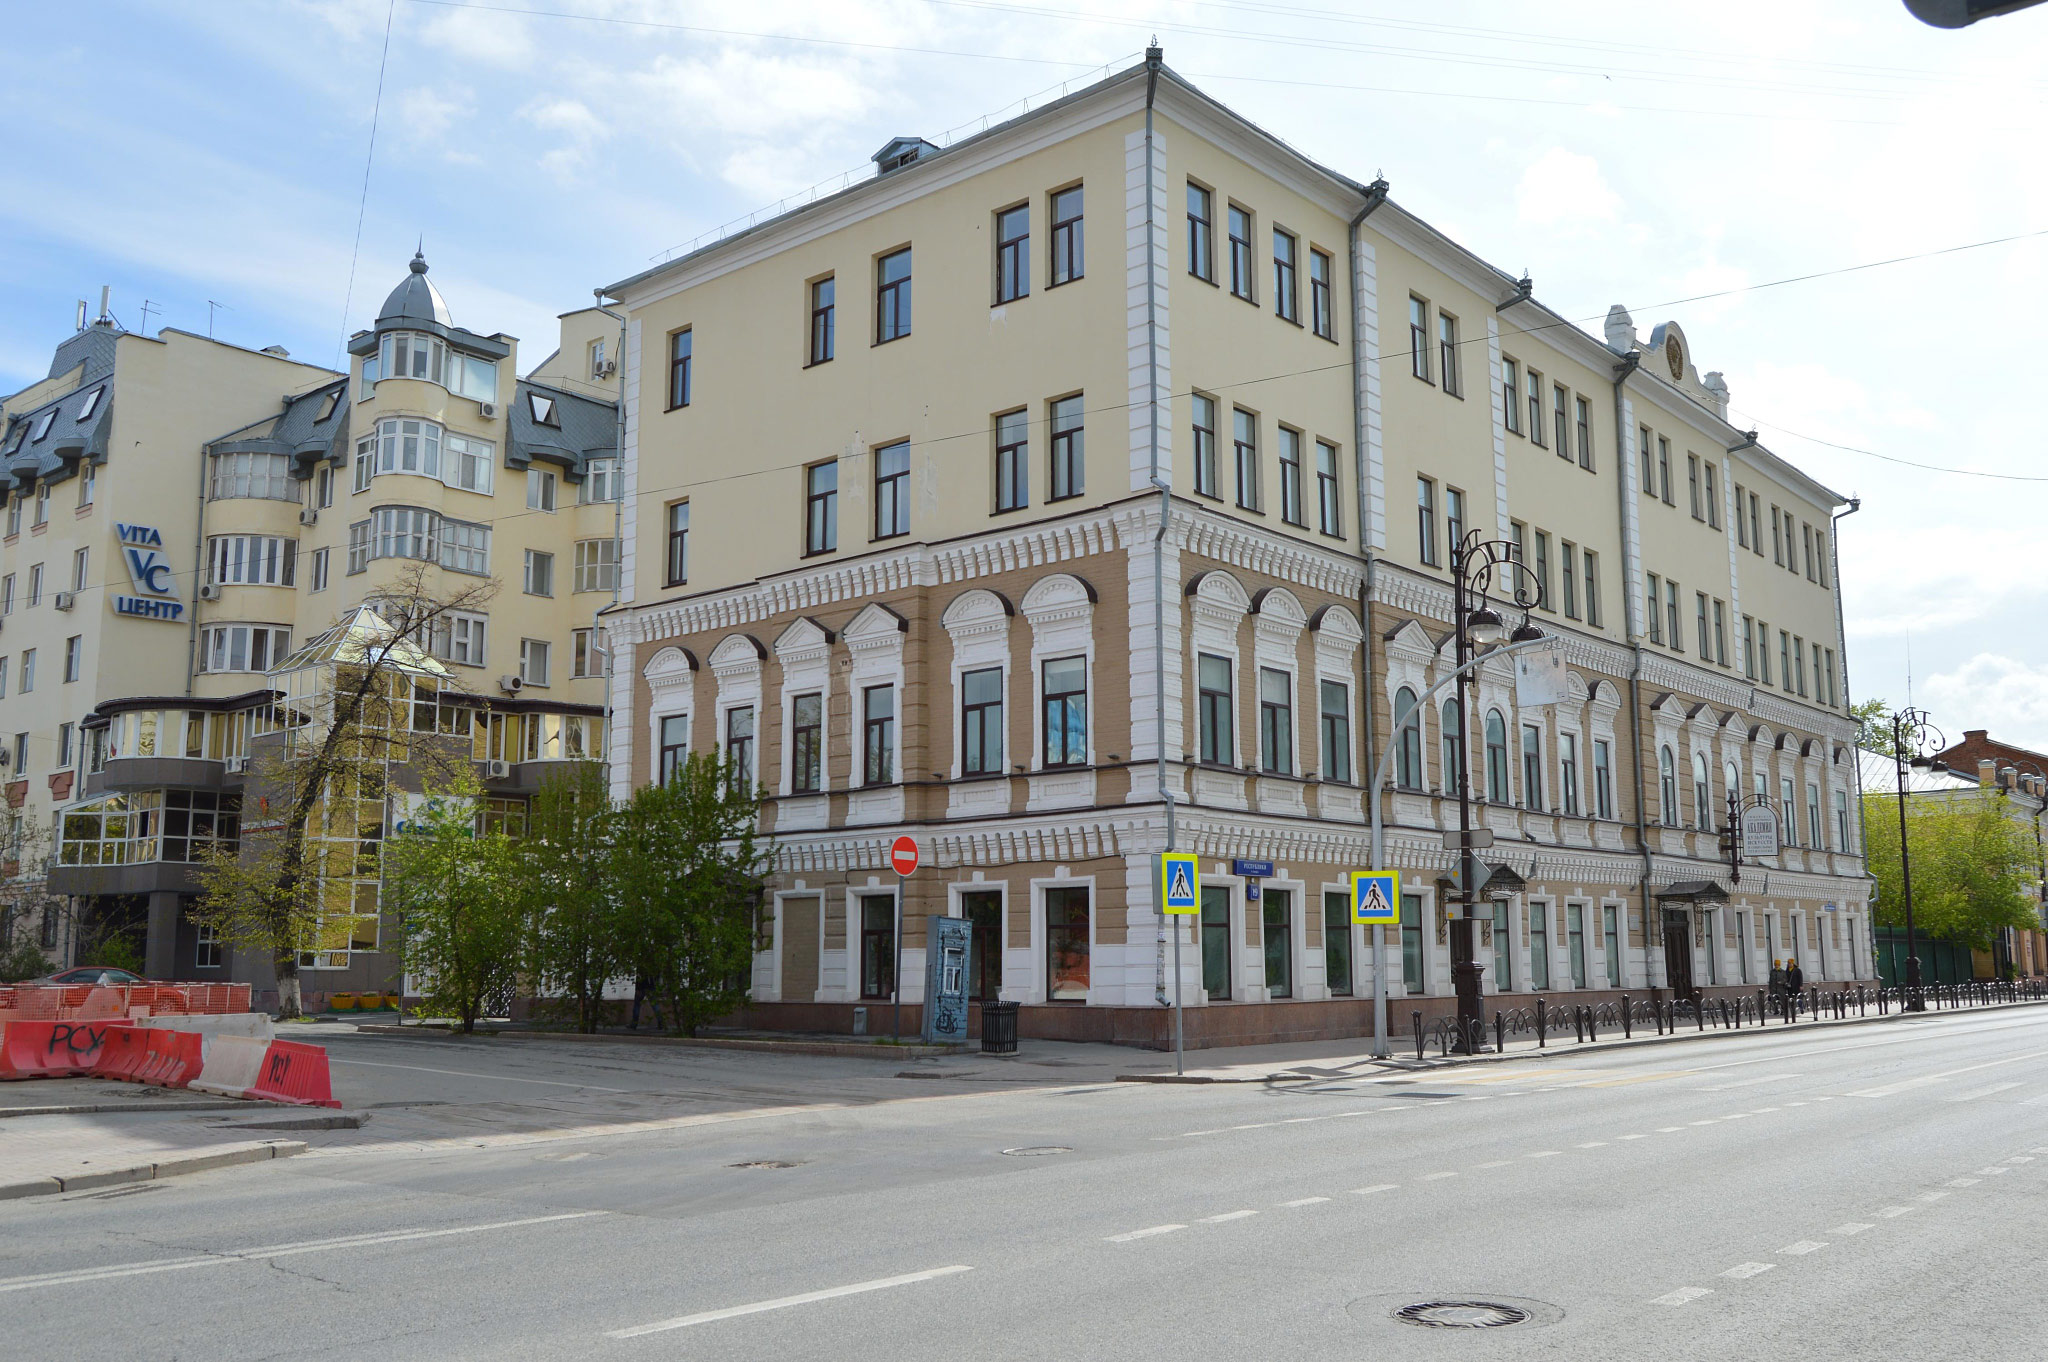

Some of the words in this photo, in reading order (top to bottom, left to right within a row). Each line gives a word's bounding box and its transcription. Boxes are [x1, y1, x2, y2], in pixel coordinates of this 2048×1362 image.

[117, 523, 162, 546] VITA
[128, 548, 170, 593] VC
[118, 596, 184, 619] ЦЕНТР
[1747, 821, 1773, 833] АКАДЕМИЯ
[1252, 887, 1259, 897] 19
